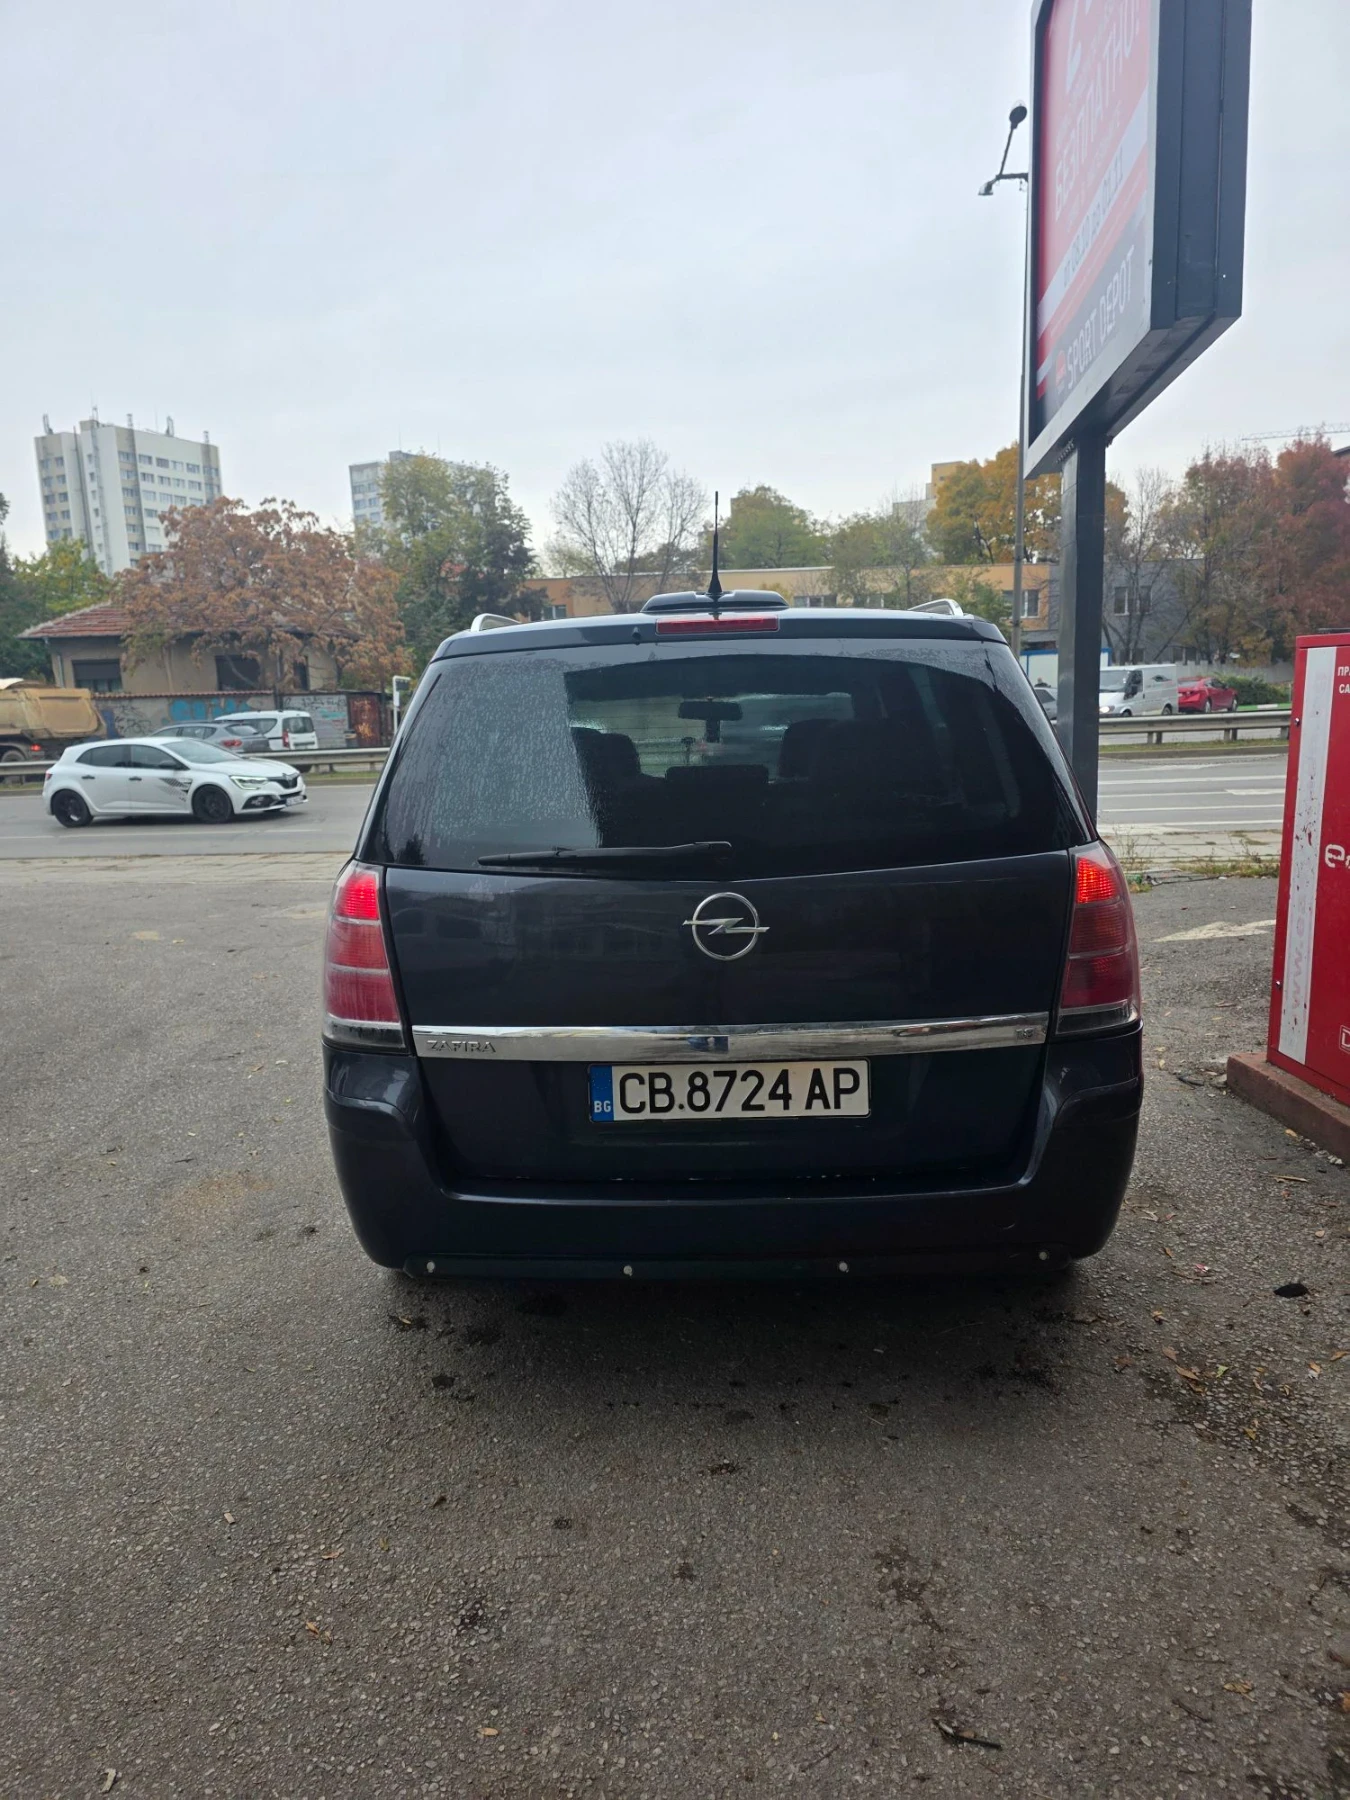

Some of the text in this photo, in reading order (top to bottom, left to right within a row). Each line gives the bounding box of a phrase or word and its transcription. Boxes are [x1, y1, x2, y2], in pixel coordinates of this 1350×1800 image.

[1067, 244, 1134, 390] SPORT DEPOT
[1337, 665, 1350, 676] ПР
[427, 1039, 497, 1053] ZAFIRA
[593, 1100, 612, 1113] BG
